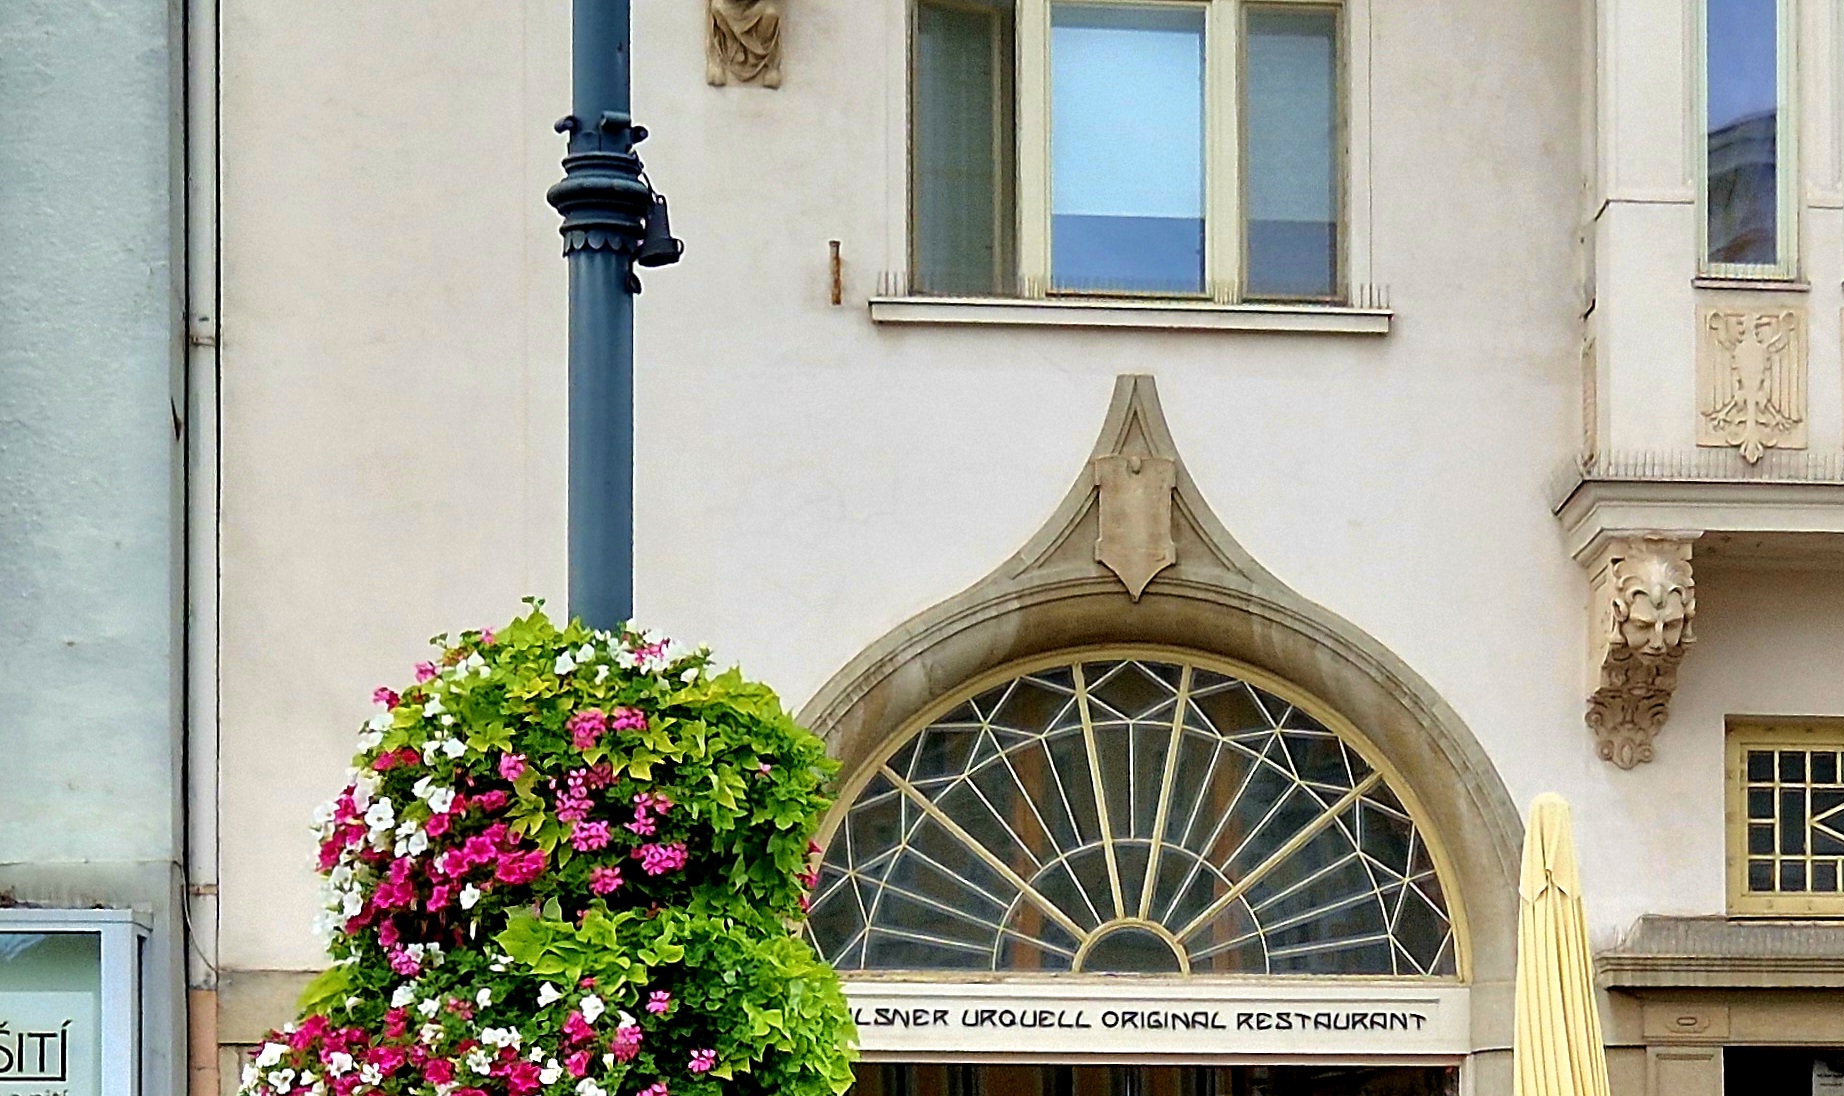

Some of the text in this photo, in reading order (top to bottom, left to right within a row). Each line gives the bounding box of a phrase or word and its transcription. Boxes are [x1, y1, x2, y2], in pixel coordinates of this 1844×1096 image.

[849, 1008, 1426, 1030] LSNER URQUELL ORIGINAL RESTAURANT
